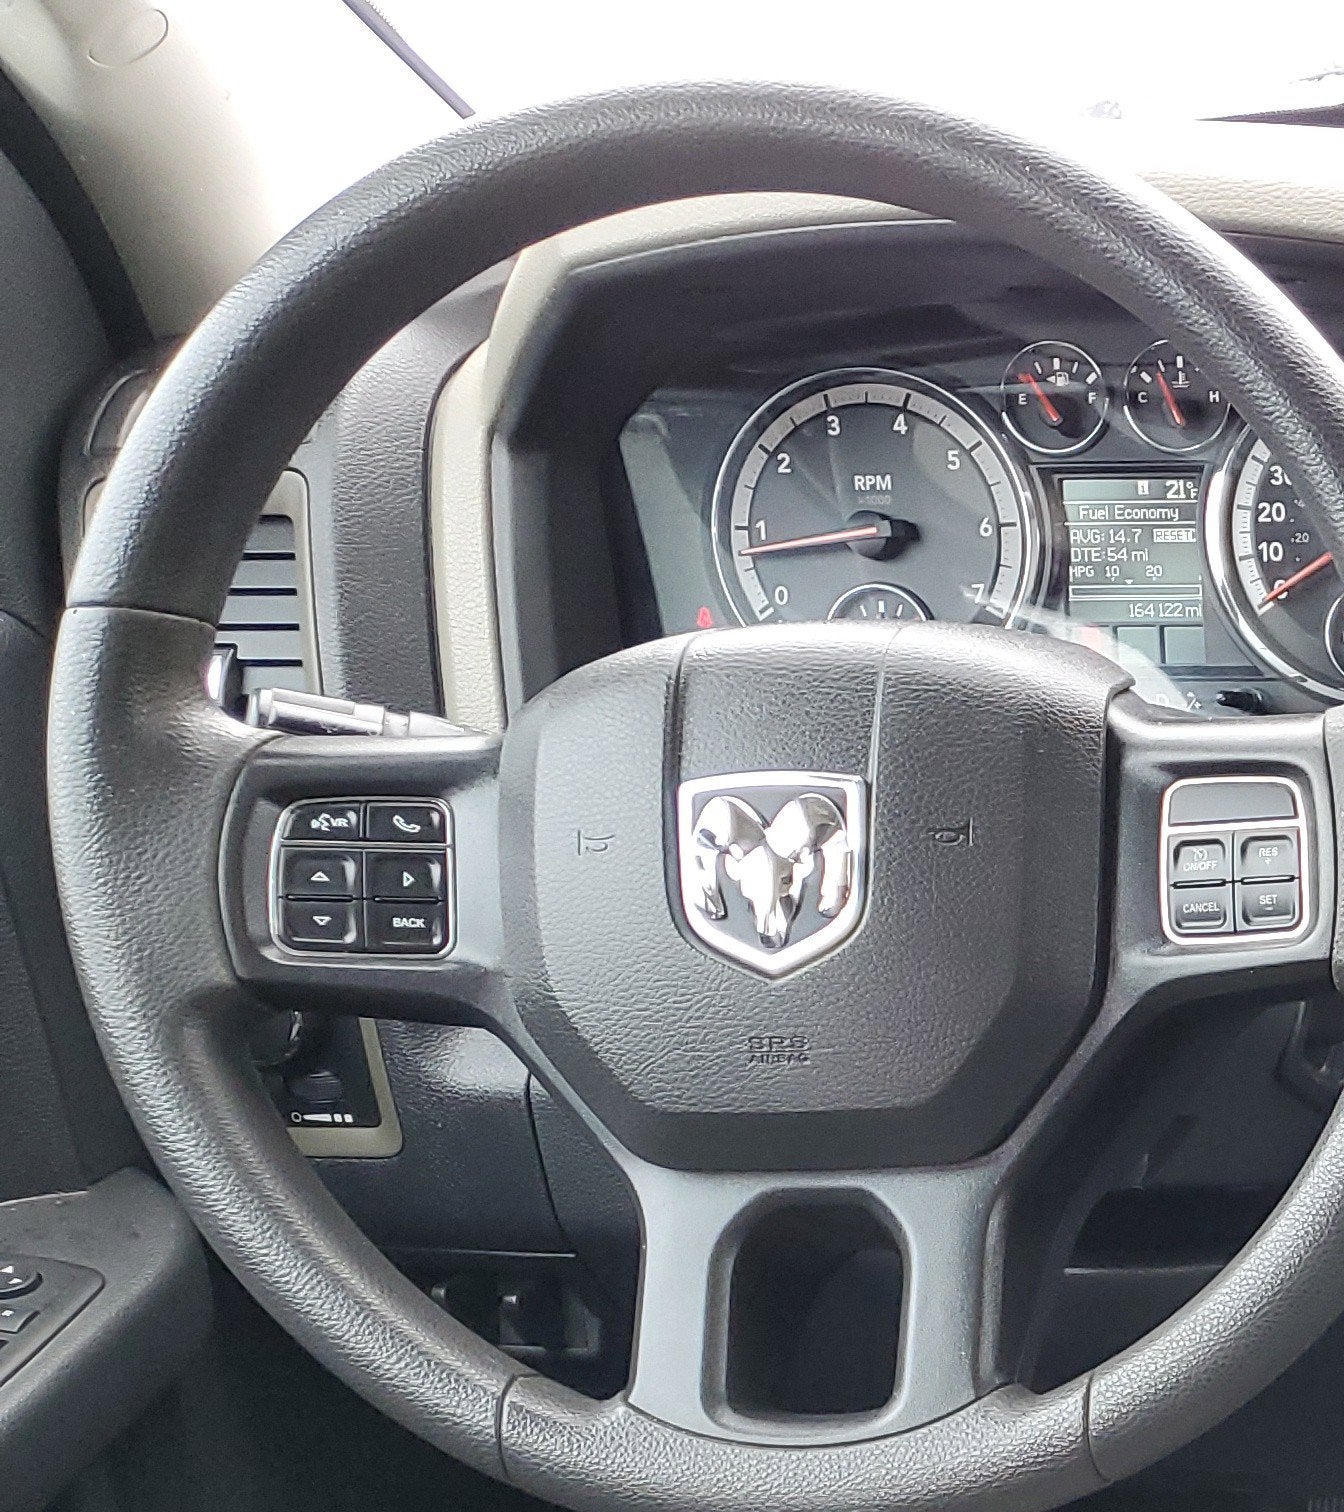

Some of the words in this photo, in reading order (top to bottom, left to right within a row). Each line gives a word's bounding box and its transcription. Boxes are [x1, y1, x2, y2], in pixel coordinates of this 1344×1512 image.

[1018, 393, 1027, 405] E
[1088, 392, 1097, 405] F
[1138, 392, 1148, 403] C
[1209, 390, 1220, 403] H
[827, 416, 841, 436] 3
[893, 413, 907, 434] 4
[777, 453, 792, 473] 2
[947, 450, 961, 470] 5
[853, 474, 892, 491] RPM
[1079, 505, 1109, 520] Fuel
[1114, 505, 1179, 521] Economy
[1258, 502, 1286, 522] 20
[755, 521, 767, 541] 1
[978, 517, 991, 536] 6
[1070, 529, 1105, 544] AVG:
[1108, 529, 1143, 544] 14.7
[1153, 528, 1197, 543] RESET
[1294, 532, 1309, 543] 20
[1107, 547, 1128, 562] 54
[1131, 548, 1149, 562] mi
[1258, 541, 1283, 562] 10
[1105, 566, 1120, 577] 10
[1145, 565, 1163, 577] 20
[774, 586, 789, 605] 0
[971, 583, 986, 604] 7
[1259, 846, 1278, 858] RES
[1259, 894, 1278, 905] SET
[1183, 901, 1220, 914] CANCEL
[392, 917, 425, 928] BACK
